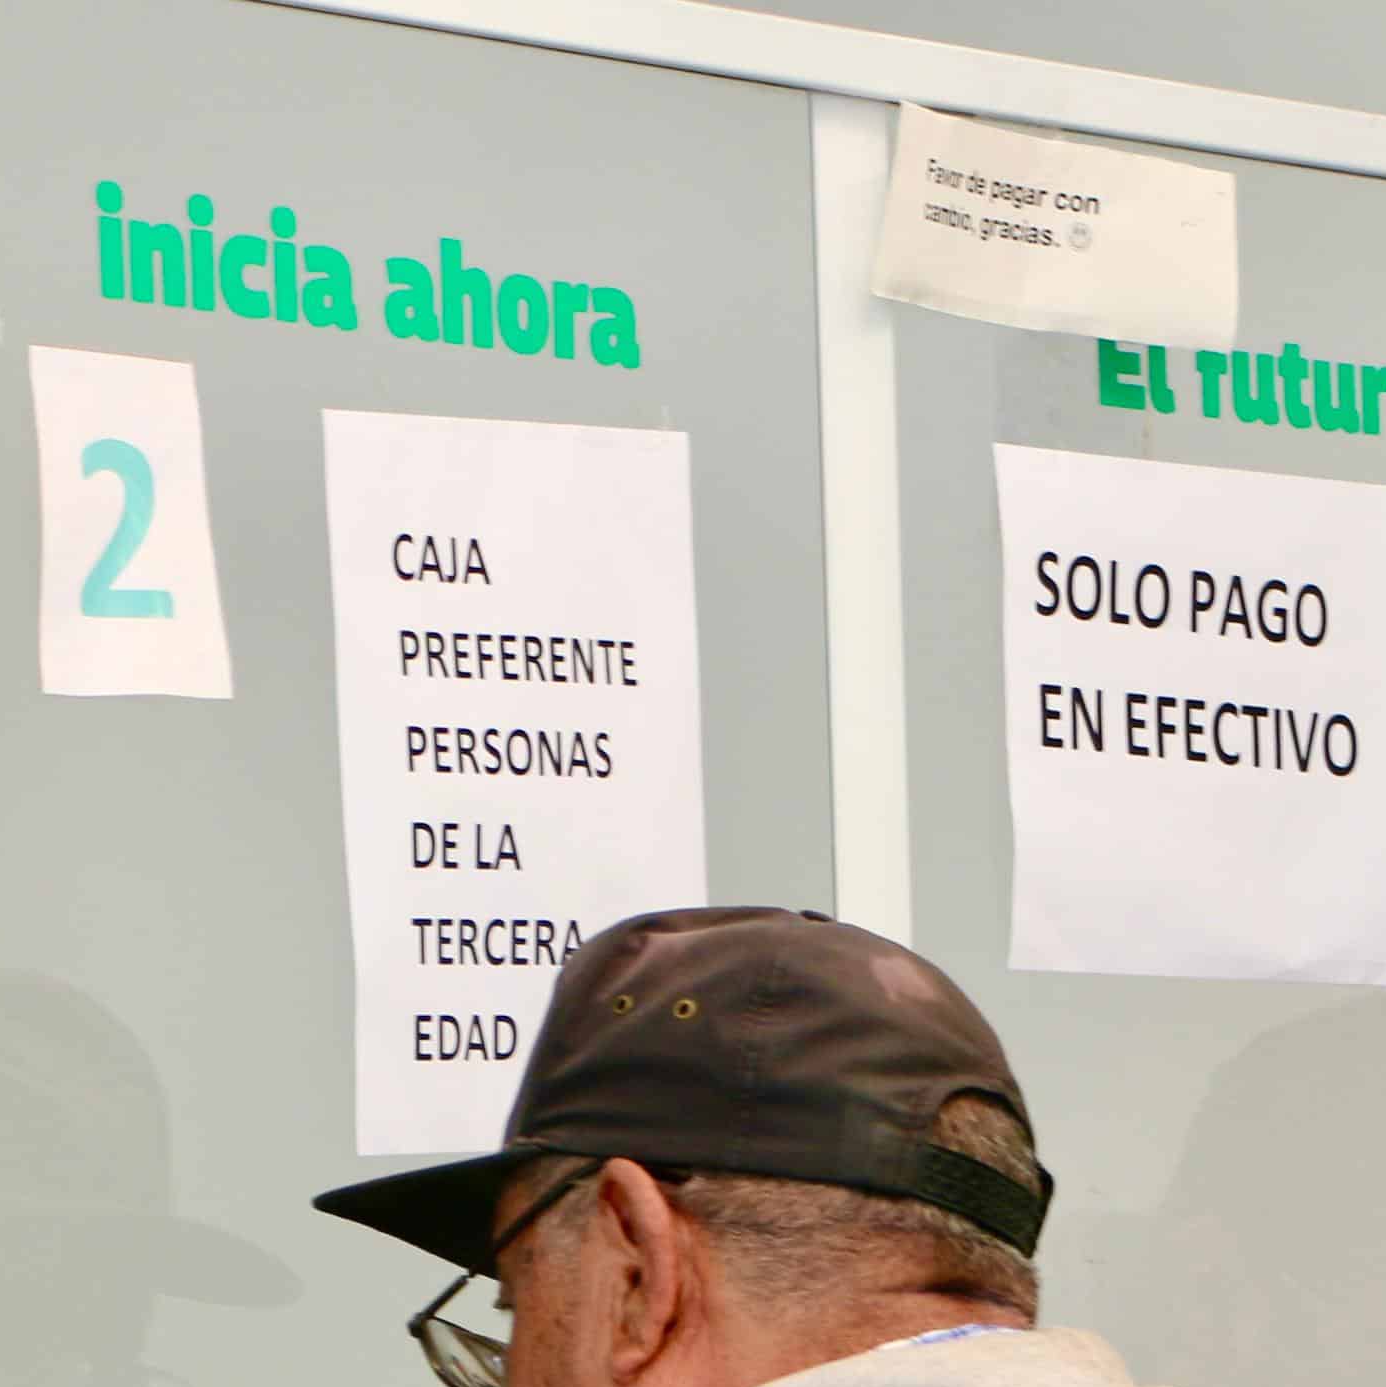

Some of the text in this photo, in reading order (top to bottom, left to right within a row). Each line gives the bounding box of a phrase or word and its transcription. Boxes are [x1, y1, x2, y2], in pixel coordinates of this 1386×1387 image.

[926, 157, 1101, 215] Favor de pagar con
[923, 201, 1061, 247] cambio, gracias.
[95, 180, 358, 331] inicia
[384, 237, 641, 369] ahora
[1098, 338, 1176, 414] El
[79, 437, 173, 621] 2
[393, 533, 491, 585] CAJA
[1035, 551, 1328, 648] SOLO PAGO
[400, 629, 639, 688] PREFERENTE
[407, 725, 613, 778] PERSONAS
[1039, 683, 1358, 777] EN EFECTIVO
[411, 821, 522, 872] DE LA
[412, 918, 585, 966] TERCERA
[415, 1014, 519, 1062] EDAD
